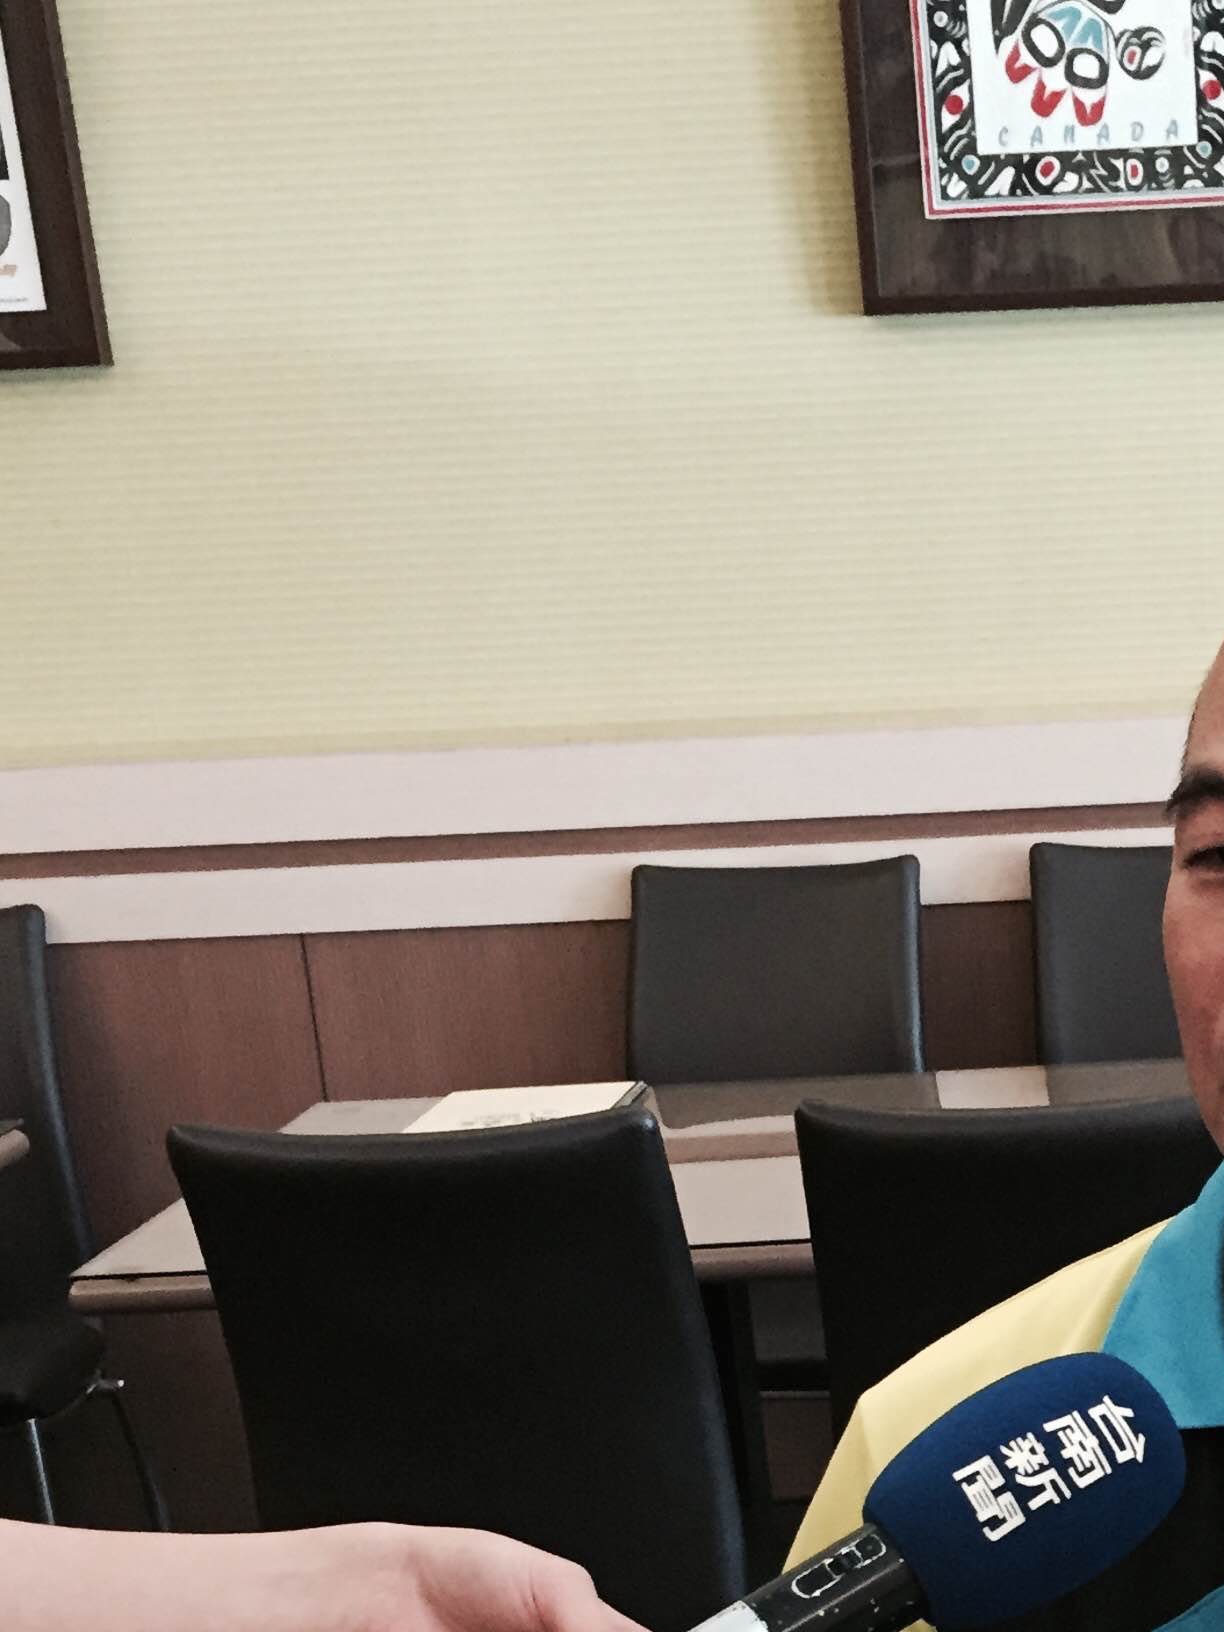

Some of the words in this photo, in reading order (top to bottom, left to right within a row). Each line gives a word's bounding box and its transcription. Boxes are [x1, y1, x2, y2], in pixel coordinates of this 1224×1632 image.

[998, 119, 1179, 147] CANADA
[952, 1394, 1146, 1542] 台南新聞
